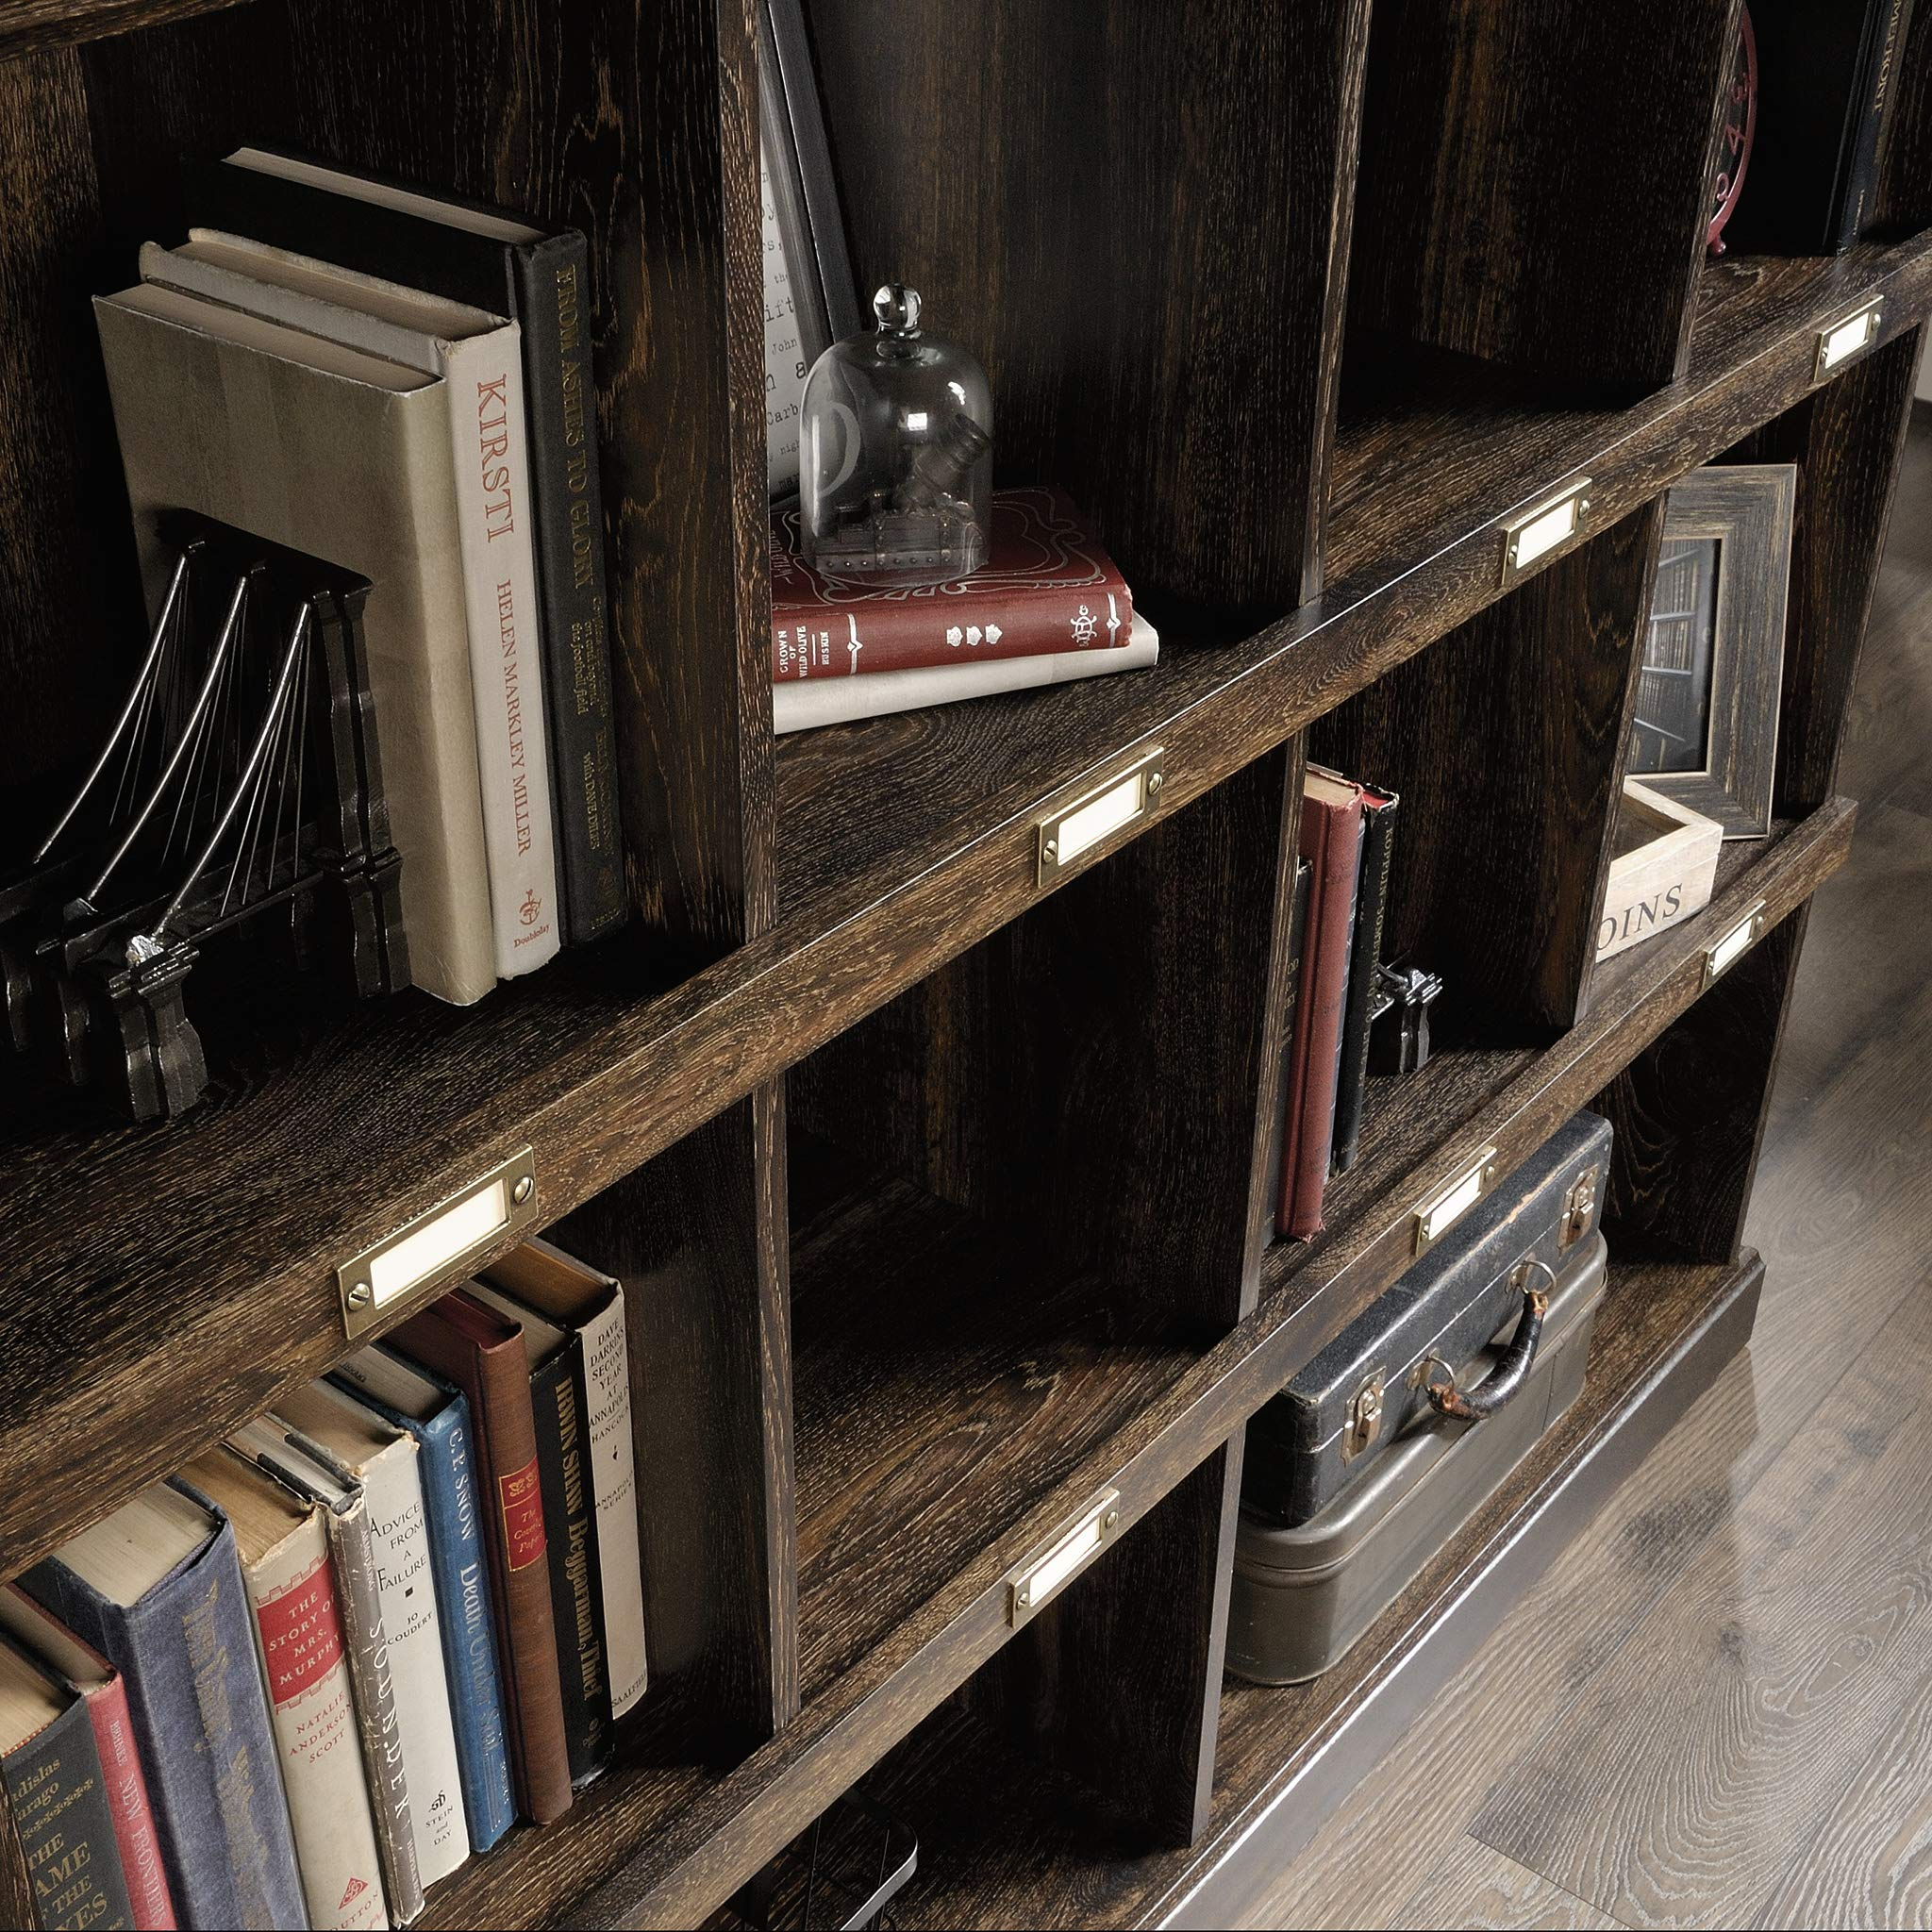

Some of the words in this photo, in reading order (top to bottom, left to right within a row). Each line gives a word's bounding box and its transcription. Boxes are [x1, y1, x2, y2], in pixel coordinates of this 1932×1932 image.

[557, 264, 579, 353] FROM
[772, 338, 798, 356] John
[561, 359, 585, 447] ASHES
[476, 373, 514, 543] KIRSTI
[567, 449, 588, 493] TO
[569, 499, 593, 590] GLORY
[497, 578, 517, 658] HELEN
[572, 622, 583, 642] the
[777, 630, 789, 674] CROWN
[789, 645, 796, 659] OF
[796, 625, 808, 654] OLIVE
[820, 631, 830, 665] RUSKIN
[571, 643, 587, 689] football
[798, 656, 808, 678] WILD
[504, 661, 525, 769] MARKLEY
[574, 689, 589, 715] field
[583, 751, 594, 782] with
[512, 774, 532, 857] MILLER
[585, 782, 597, 814] DAVE
[513, 924, 550, 949] Doubleday
[597, 1317, 619, 1346] DAVE
[591, 1342, 624, 1381] SECOND
[599, 1363, 623, 1391] YEAR
[607, 1384, 618, 1401] AT
[556, 1375, 578, 1452] IRWIN
[562, 1449, 583, 1515] SHAW
[455, 1473, 475, 1541] SNOW
[390, 1518, 425, 1550] FROM
[403, 1550, 412, 1561] A
[288, 1591, 318, 1619] THE
[460, 1561, 487, 1634] Death
[269, 1612, 318, 1651] STORY
[387, 1611, 434, 1645] COUDERT
[407, 1611, 419, 1625] JO
[279, 1631, 341, 1686] MURPHY
[293, 1630, 326, 1657] MRS.
[580, 1640, 604, 1702] Thief
[290, 1702, 352, 1756] ANDERSON
[295, 1690, 345, 1734] NATALIE
[370, 1617, 409, 1820] SOUNDER
[309, 1728, 345, 1763] SCOTT
[121, 1772, 143, 1822] NEW
[425, 1805, 453, 1827] STEIN
[434, 1830, 451, 1845] DAY
[52, 1874, 92, 1915] THE
[131, 1825, 168, 1928] FRONTIERS
